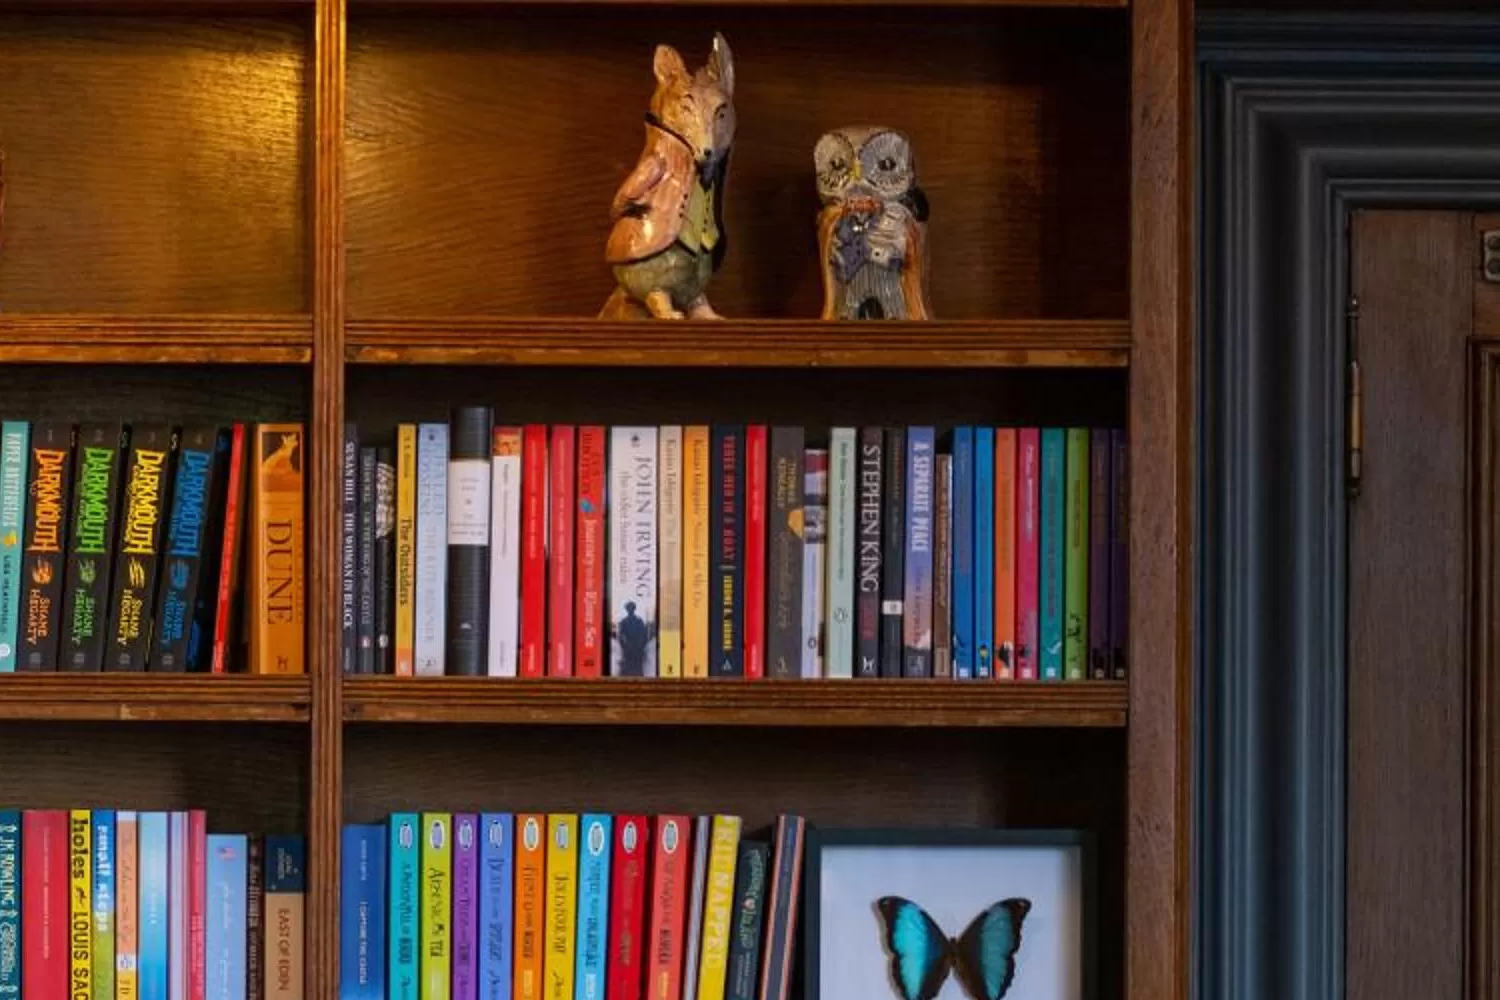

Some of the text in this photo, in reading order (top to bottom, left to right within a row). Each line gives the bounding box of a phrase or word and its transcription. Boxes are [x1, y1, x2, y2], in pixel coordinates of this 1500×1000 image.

[345, 442, 354, 477] SUSAN
[26, 448, 66, 552] DARKMOUTH
[74, 447, 115, 553] DARKMOUTH
[122, 449, 165, 554] DARKMOUTH
[166, 449, 211, 558] DARKMOUTH
[345, 480, 353, 503] HILL
[860, 445, 881, 593] STEPHEN KING
[344, 536, 353, 577] WOMAN
[635, 456, 652, 598] JOHN IRVING
[266, 519, 293, 625] DUNE
[399, 518, 412, 606] The Outsiders
[27, 589, 51, 645] SHANE HEGARTY
[117, 589, 133, 646] HEGARTY
[343, 593, 352, 629] BLACK
[73, 817, 87, 879] holes
[73, 911, 87, 961] LOUIS
[278, 908, 290, 937] EAST
